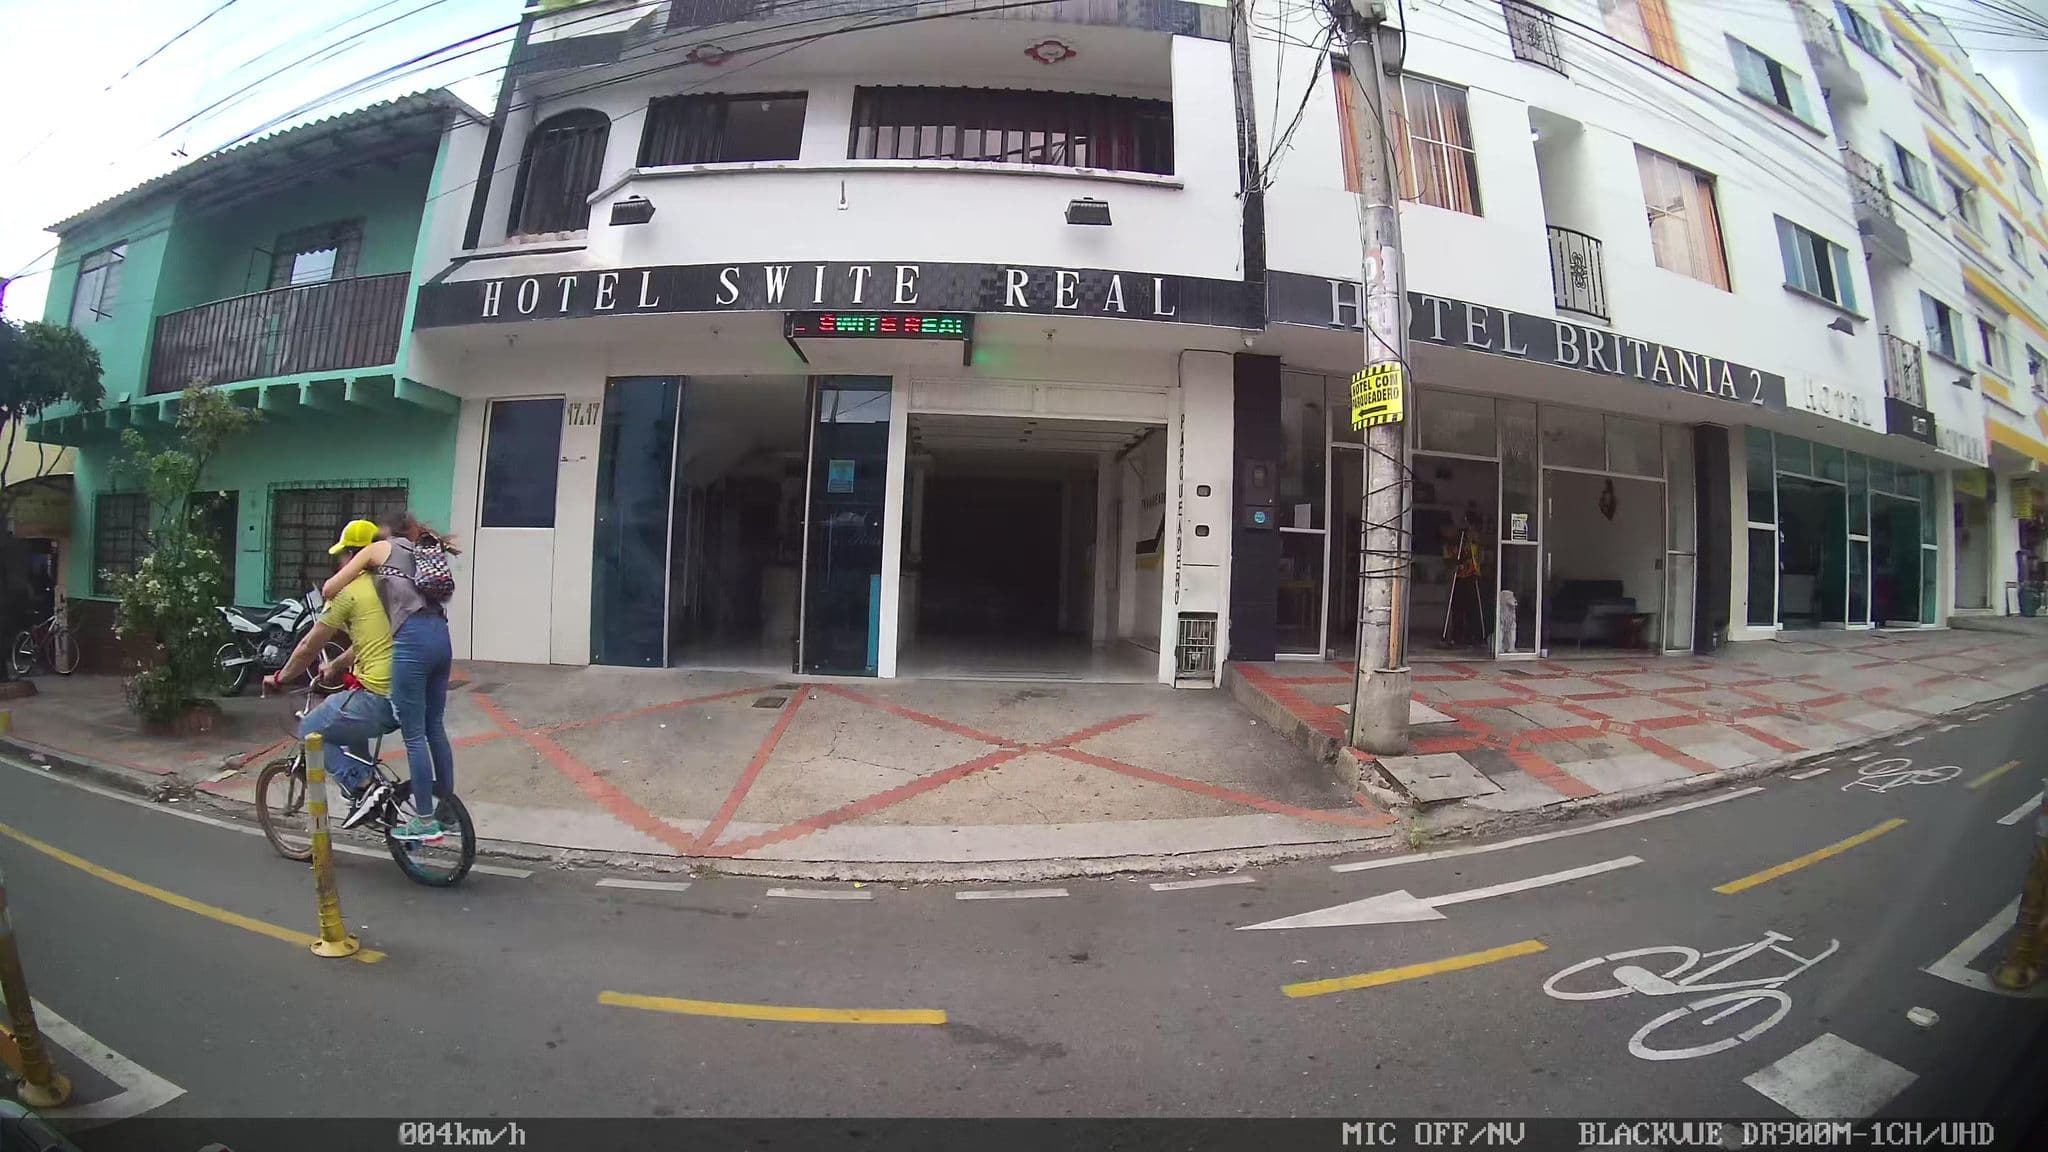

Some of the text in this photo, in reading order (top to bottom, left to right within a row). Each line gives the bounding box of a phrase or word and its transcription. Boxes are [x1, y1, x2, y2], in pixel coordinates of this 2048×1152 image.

[481, 264, 1176, 318] HOTEL SWITE REAL
[819, 314, 897, 332] SWITE
[1329, 280, 1765, 405] HTEL BRITANIA 2
[1352, 373, 1398, 395] HOTEL CON
